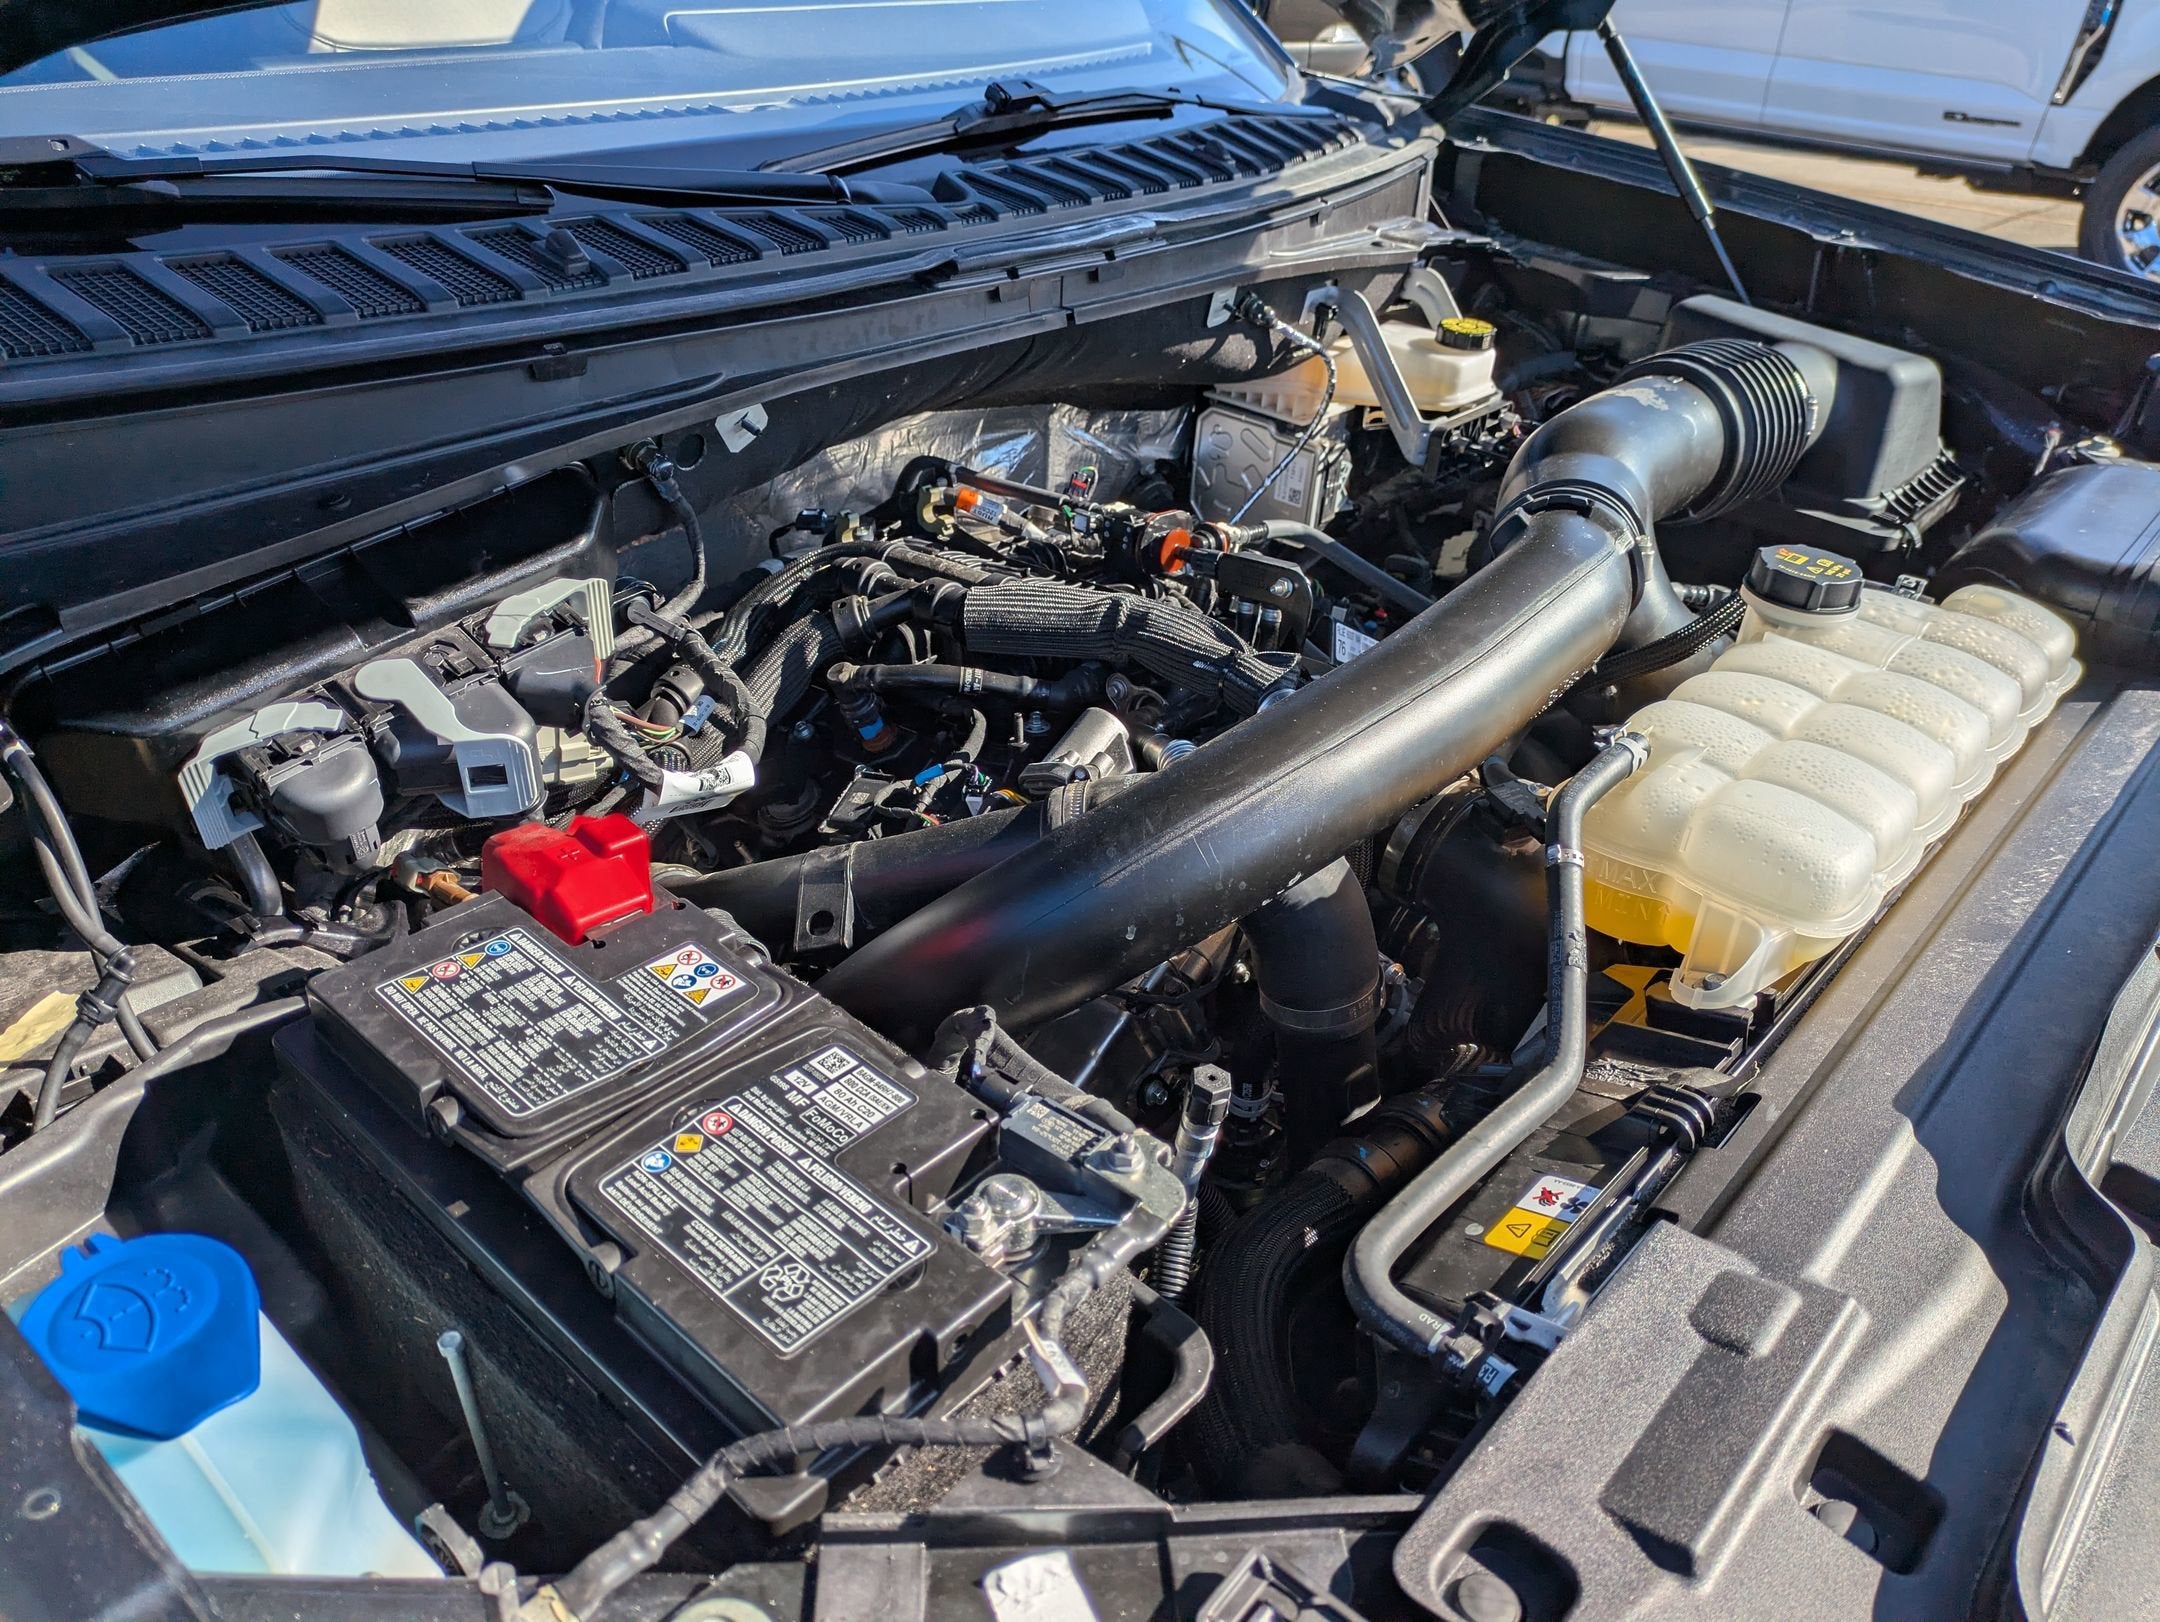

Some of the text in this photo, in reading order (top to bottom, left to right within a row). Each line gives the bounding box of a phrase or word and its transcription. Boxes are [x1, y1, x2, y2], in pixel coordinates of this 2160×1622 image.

[1599, 860, 1660, 894] MAX
[381, 985, 398, 995] DO
[515, 937, 566, 974] DANGER/POISON
[568, 980, 622, 1020] PELIGRO/VENENO
[389, 992, 408, 1004] NOT
[422, 1022, 439, 1033] PAS
[792, 1075, 811, 1088] 12V
[842, 1077, 859, 1089] 800
[854, 1085, 872, 1097] CCA
[783, 1089, 812, 1109] MF
[816, 1095, 865, 1128] AGM/VRLA
[832, 1088, 876, 1118] 80 Ah C20
[802, 1108, 852, 1143] FoMoCo
[735, 1108, 799, 1156] DANGER/POISON
[805, 1163, 874, 1214] PELIGRO/VENENO
[623, 1174, 642, 1189] Lead
[636, 1185, 654, 1199] Acid
[631, 1169, 679, 1210] NON-SPILLABLE
[689, 1218, 718, 1242] CONTRA
[713, 1239, 752, 1272] DERRAMES
[1417, 1312, 1441, 1330] RAD
